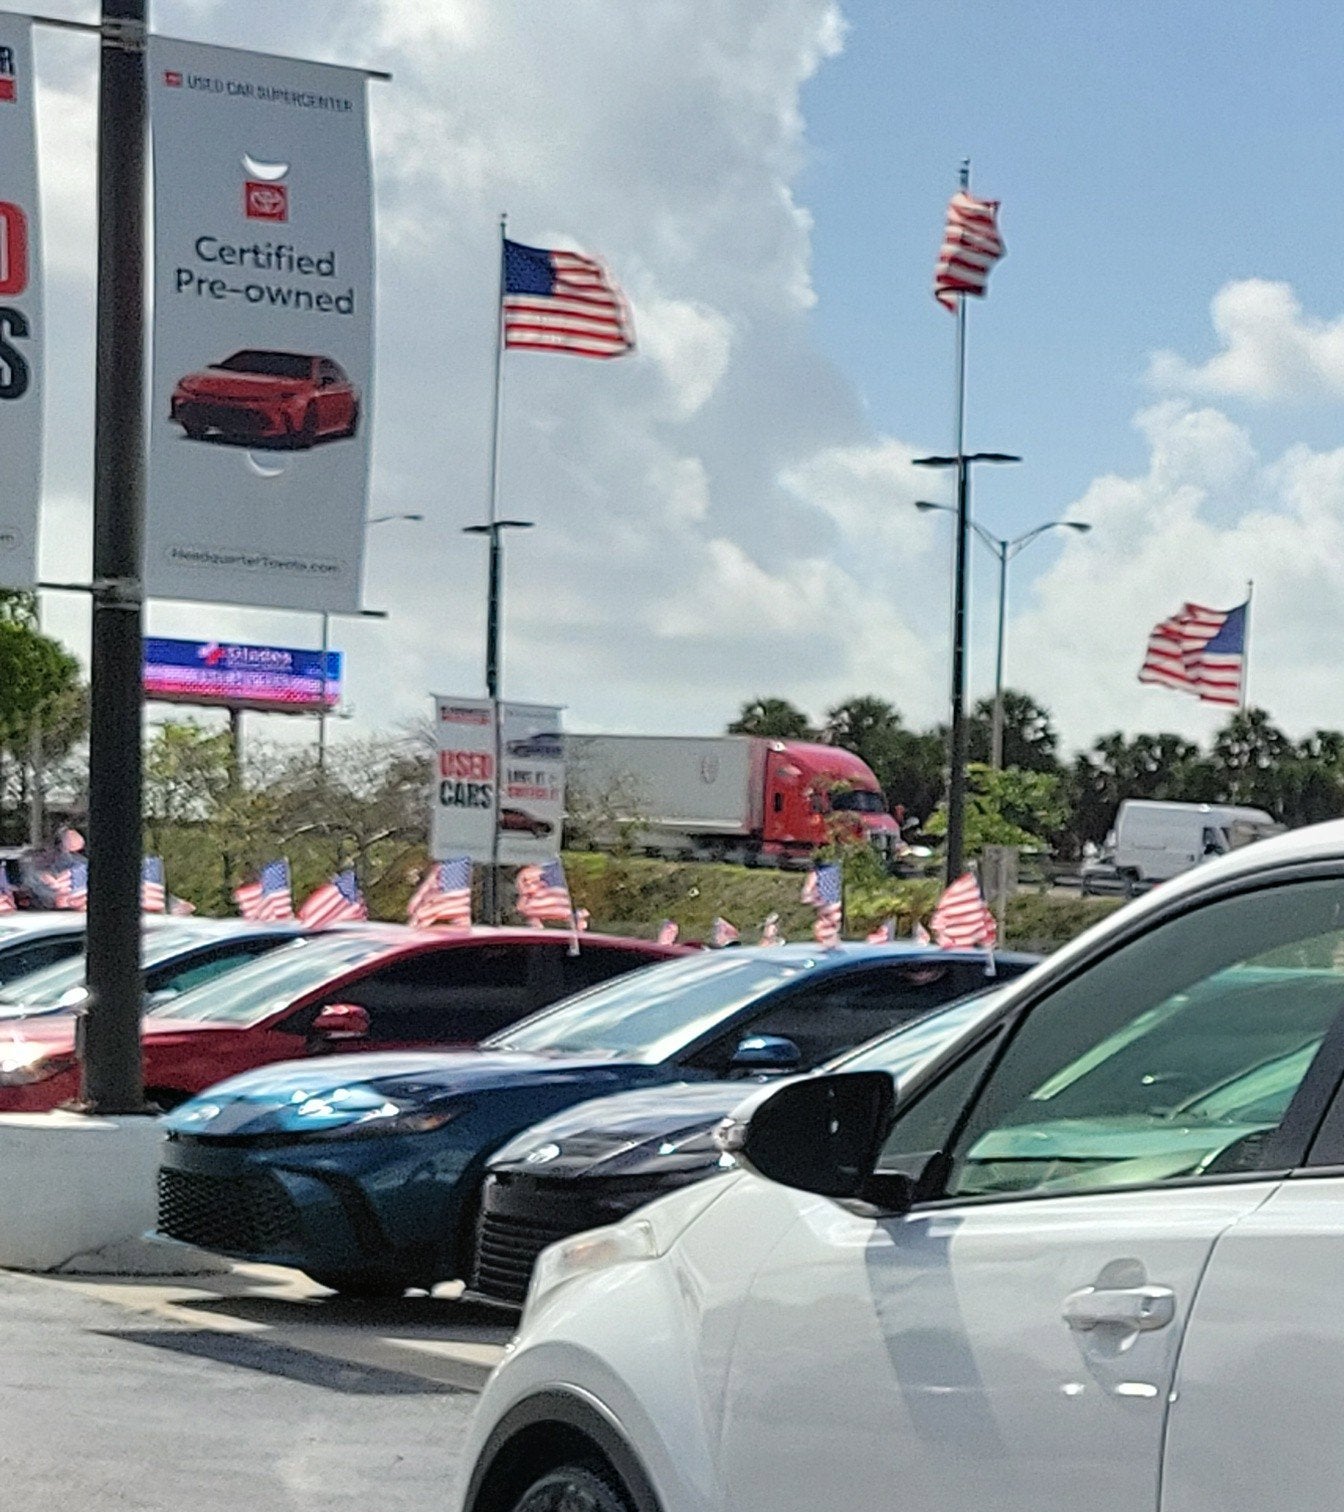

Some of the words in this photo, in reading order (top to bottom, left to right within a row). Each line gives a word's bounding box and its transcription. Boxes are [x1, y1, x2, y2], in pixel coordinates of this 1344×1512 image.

[187, 75, 224, 94] USED
[227, 81, 253, 98] CAR
[257, 85, 353, 113] SUPERCENTER
[195, 235, 335, 277] Certified
[176, 267, 354, 315] Pre-owned
[440, 750, 493, 780] USED
[439, 780, 493, 809] CARS
